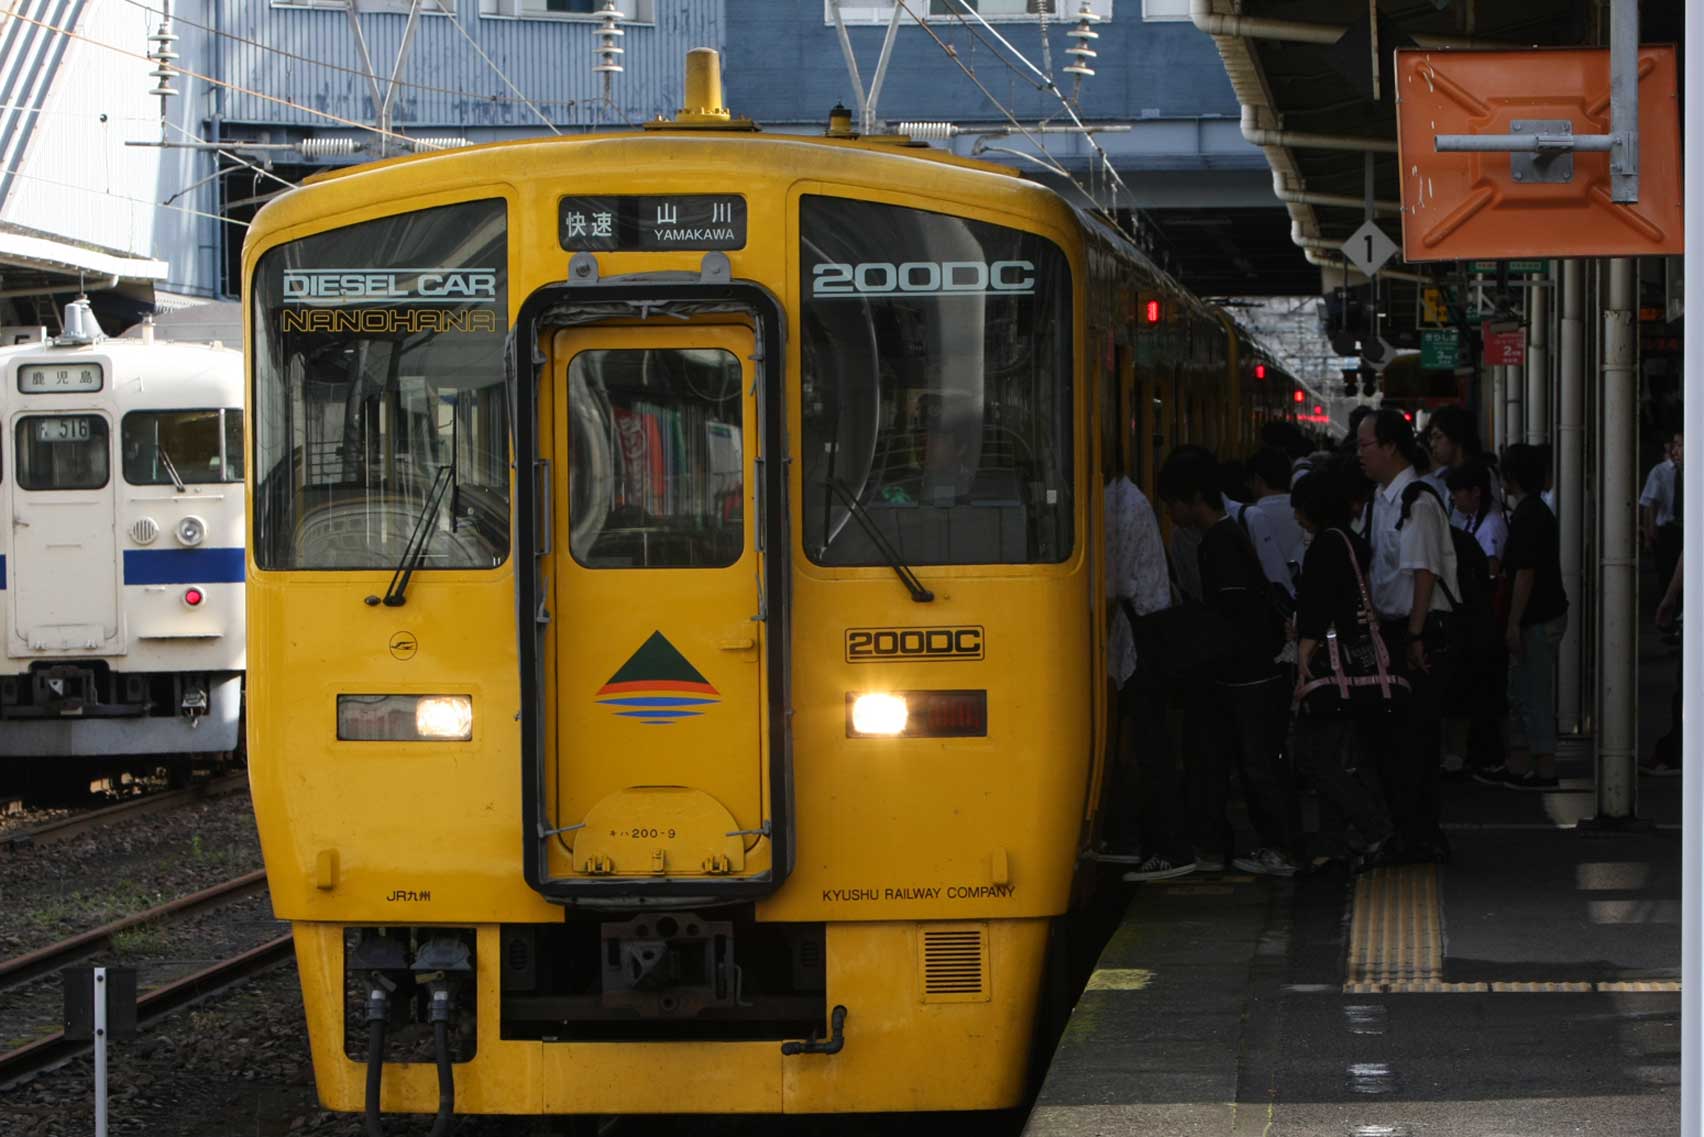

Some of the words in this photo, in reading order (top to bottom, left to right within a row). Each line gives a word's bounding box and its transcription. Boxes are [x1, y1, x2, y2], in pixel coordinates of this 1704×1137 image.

[566, 211, 613, 239] 快速
[654, 228, 735, 241] YAMAKAWA
[1363, 234, 1373, 264] 1
[283, 273, 409, 297] DIESEL
[417, 272, 496, 296] CAR
[812, 260, 1036, 292] 200DC
[282, 309, 496, 333] NANOHANA
[32, 369, 93, 385] 鹿児島
[848, 629, 981, 655] 200DC
[386, 889, 431, 902] JR九州
[822, 888, 880, 902] KYUSHU
[884, 887, 941, 900] RAILWAY
[946, 886, 1016, 899] COMPANY
